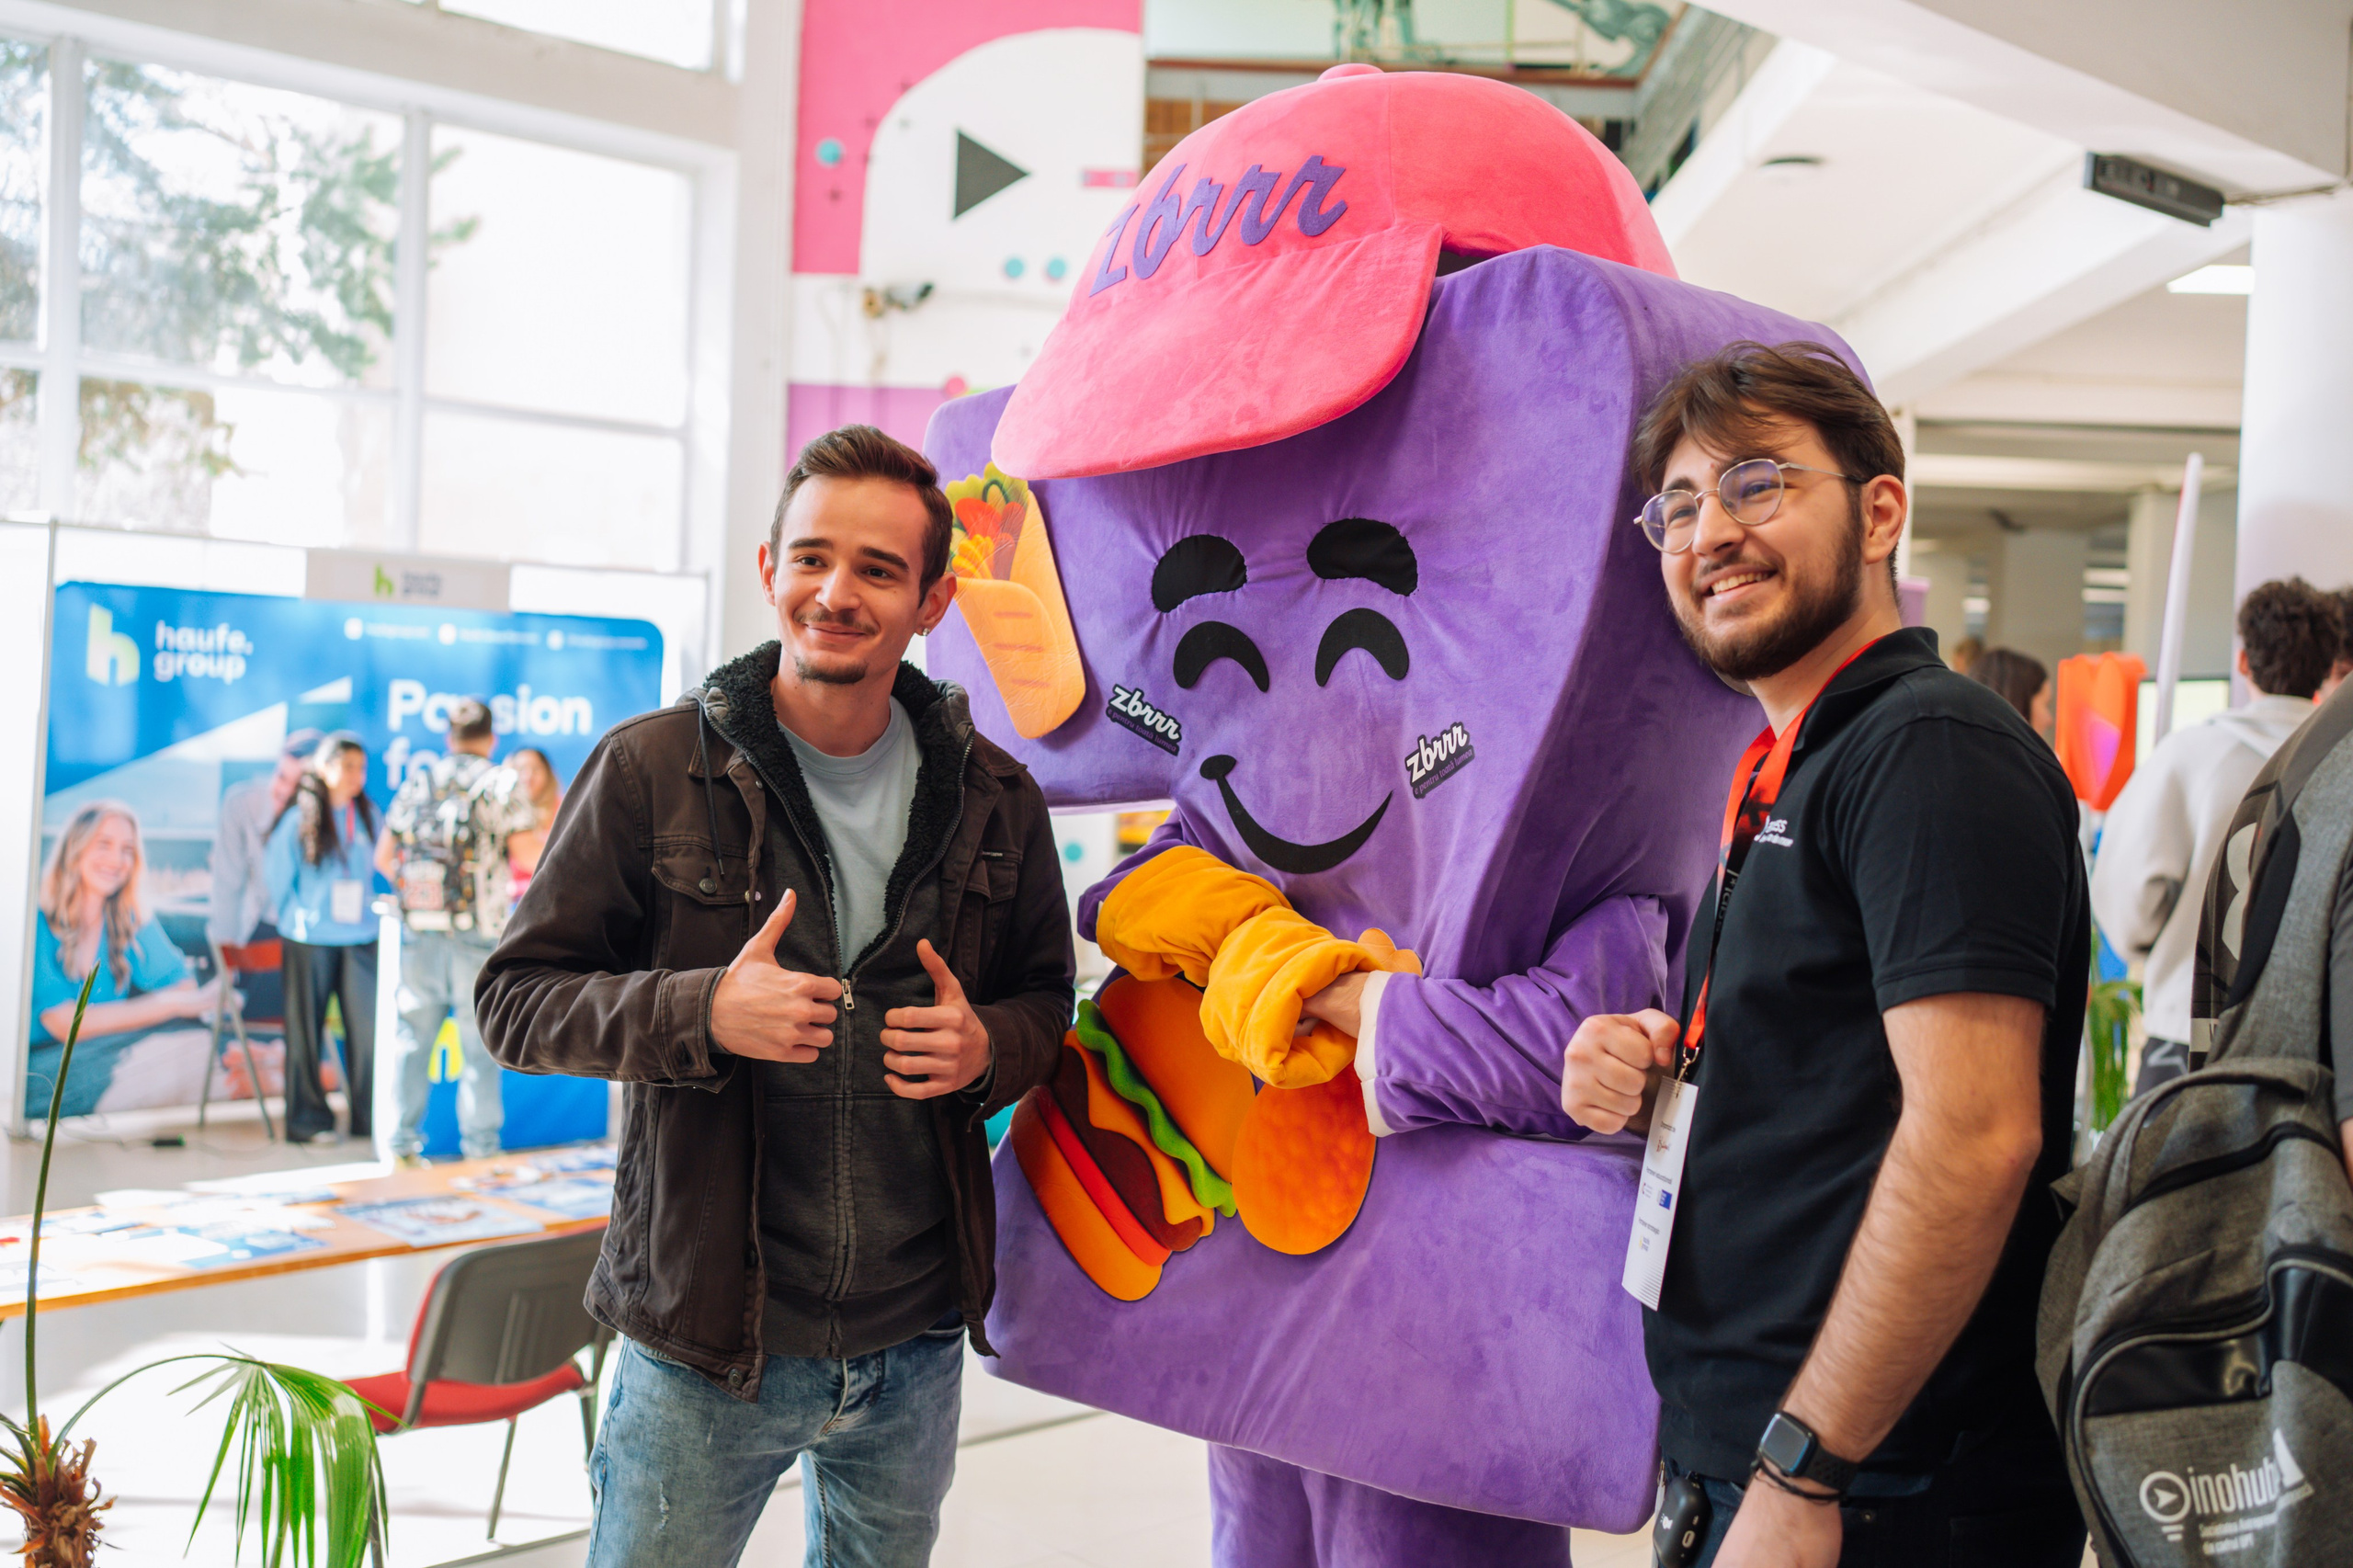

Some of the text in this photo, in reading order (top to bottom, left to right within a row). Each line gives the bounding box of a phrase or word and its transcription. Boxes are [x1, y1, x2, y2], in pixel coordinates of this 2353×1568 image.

[1089, 154, 1348, 297] zbrrr
[153, 650, 247, 686] group
[387, 678, 594, 735] Pasion
[1109, 686, 1180, 740] zbrrr
[1112, 711, 1135, 729] pentru
[1154, 734, 1177, 753] lumea
[1406, 725, 1468, 783] zbrrr
[1419, 774, 1439, 794] pentru
[1454, 748, 1473, 767] lumea
[2187, 1456, 2281, 1515] inohub
